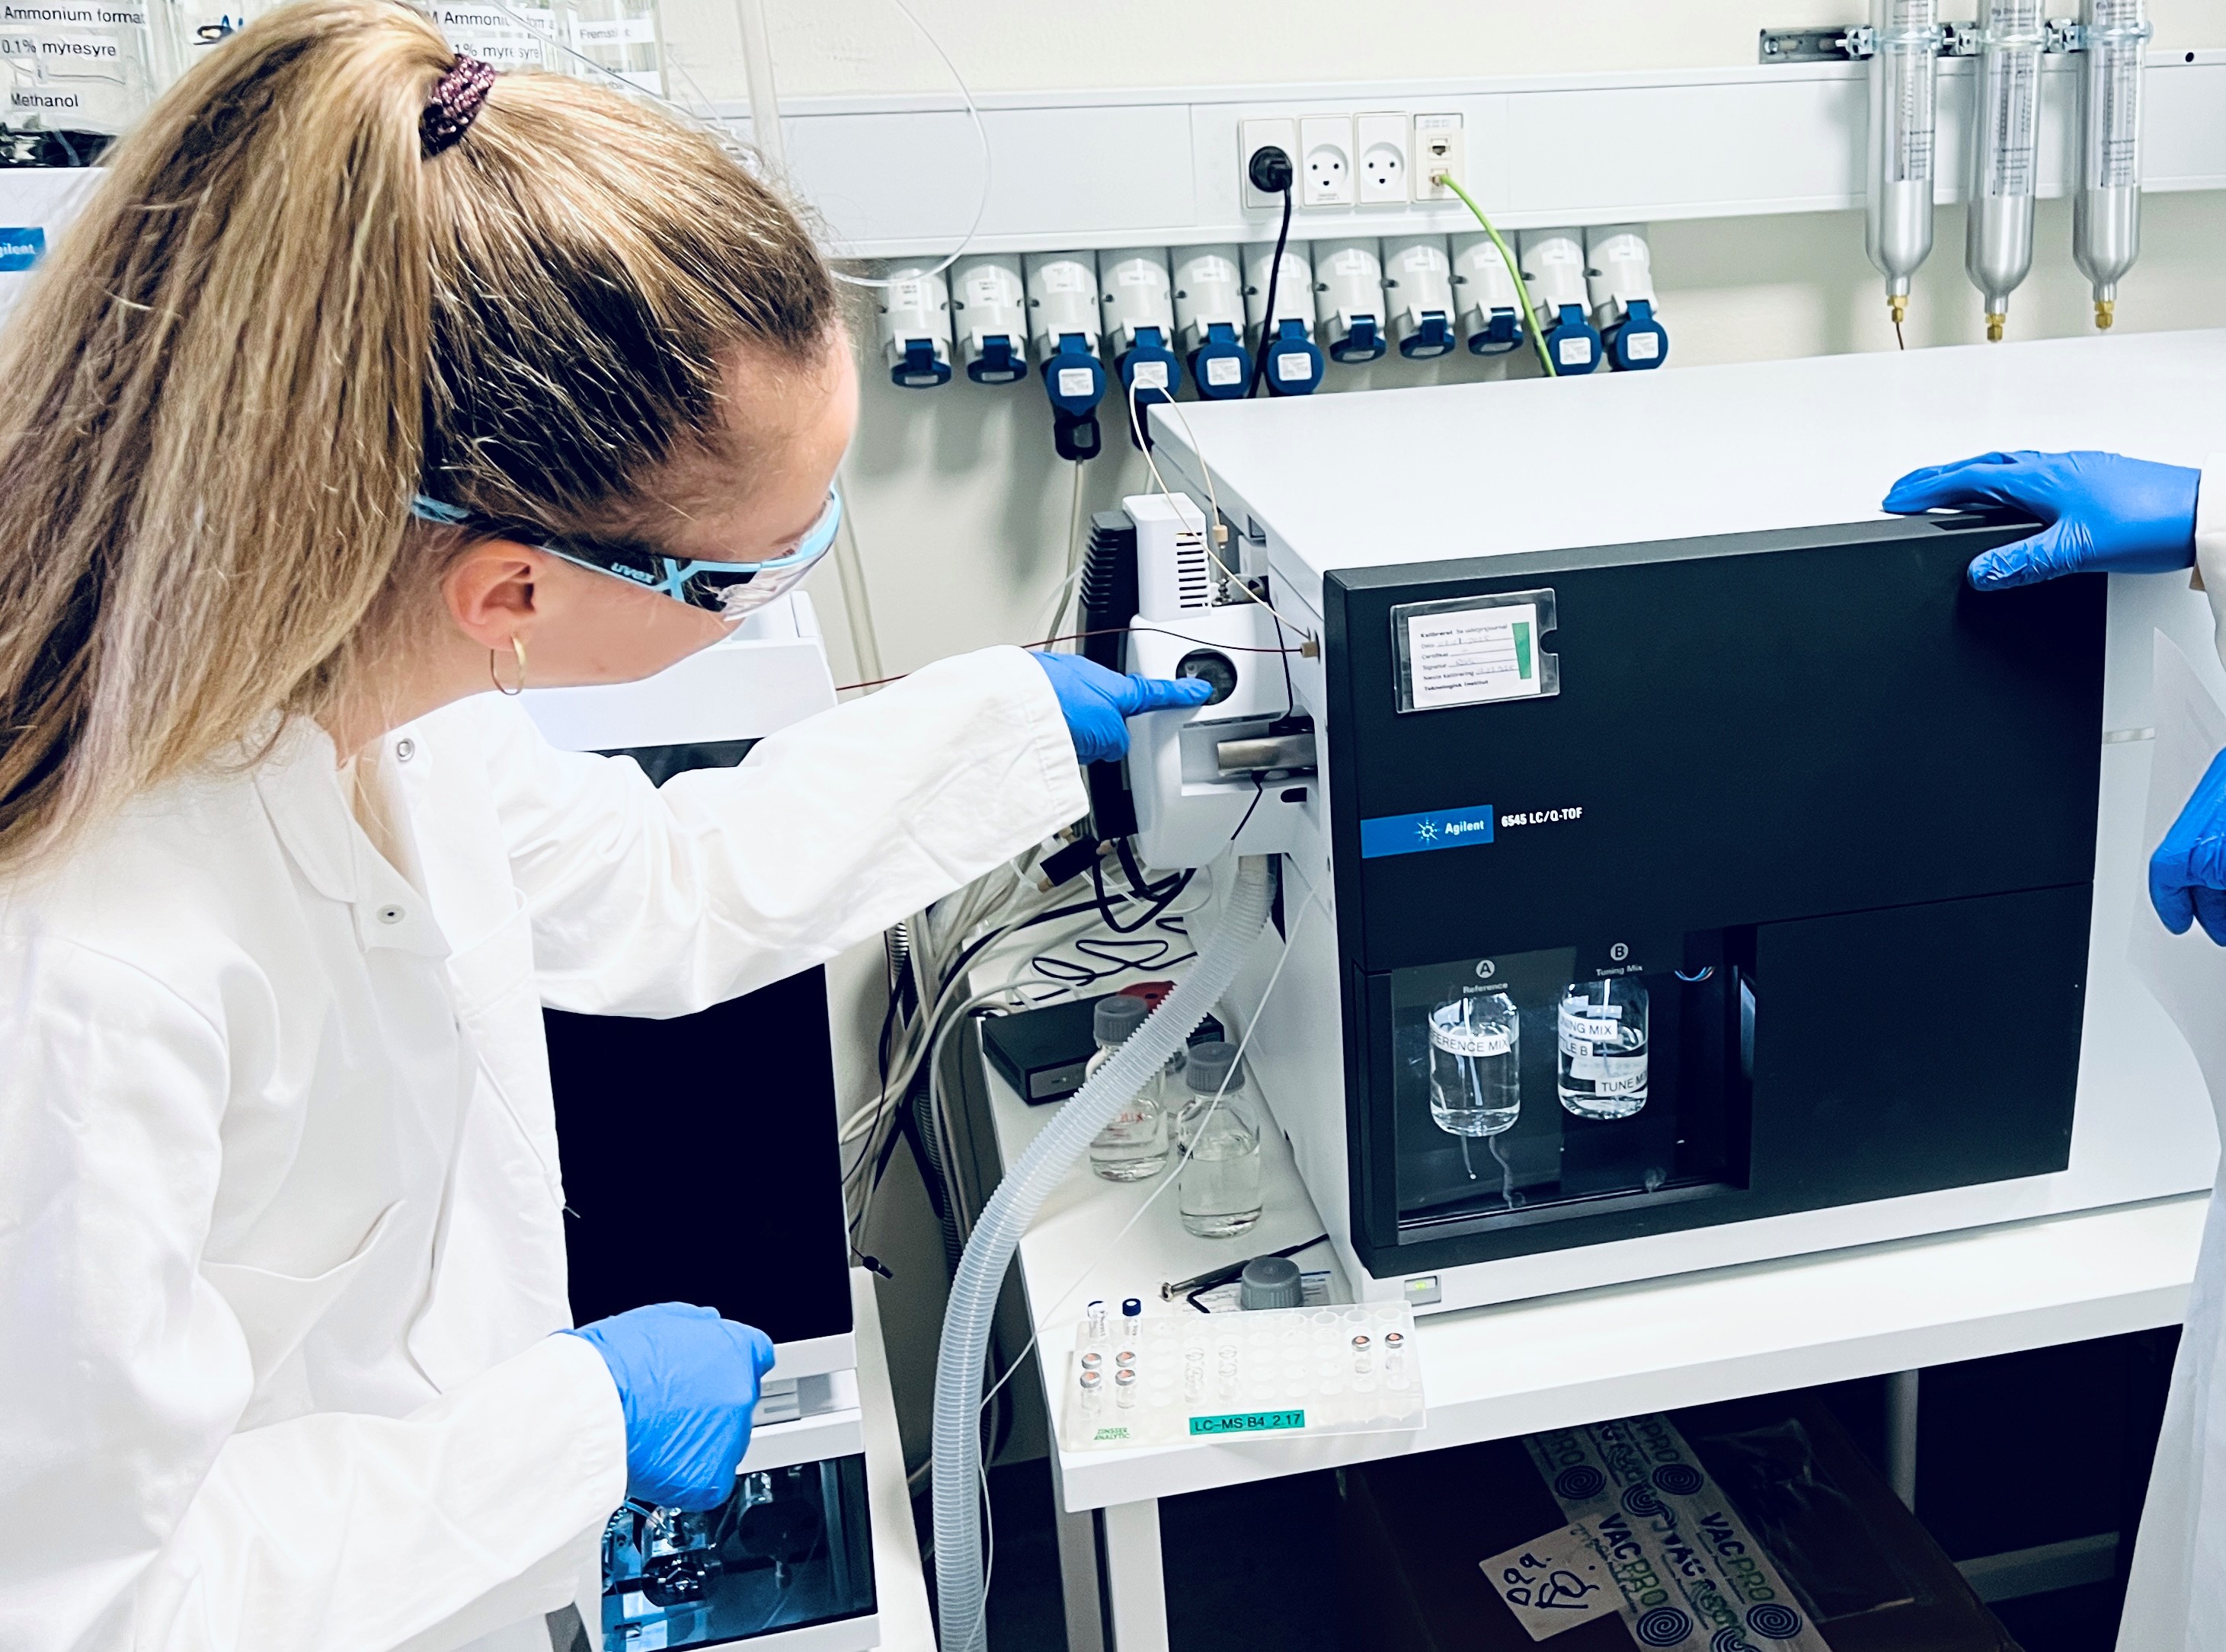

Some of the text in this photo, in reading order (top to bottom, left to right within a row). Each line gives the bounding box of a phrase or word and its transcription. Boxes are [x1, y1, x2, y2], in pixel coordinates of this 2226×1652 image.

[4, 6, 92, 21] Ammonium
[2, 39, 116, 57] 0.1% myresyre
[11, 93, 78, 107] Methanol
[610, 561, 655, 584] uvex
[1444, 807, 1583, 836] Agilent 6545 LC/Q-TOF
[1596, 967, 1625, 976] Tuning
[1463, 983, 1508, 994] Reference
[1589, 1024, 1612, 1035] MIX
[1488, 1039, 1509, 1052] MIX
[1580, 1046, 1588, 1056] B
[1601, 1078, 1634, 1093] TUNE
[1195, 1413, 1301, 1432] LC-MS B4 2.17
